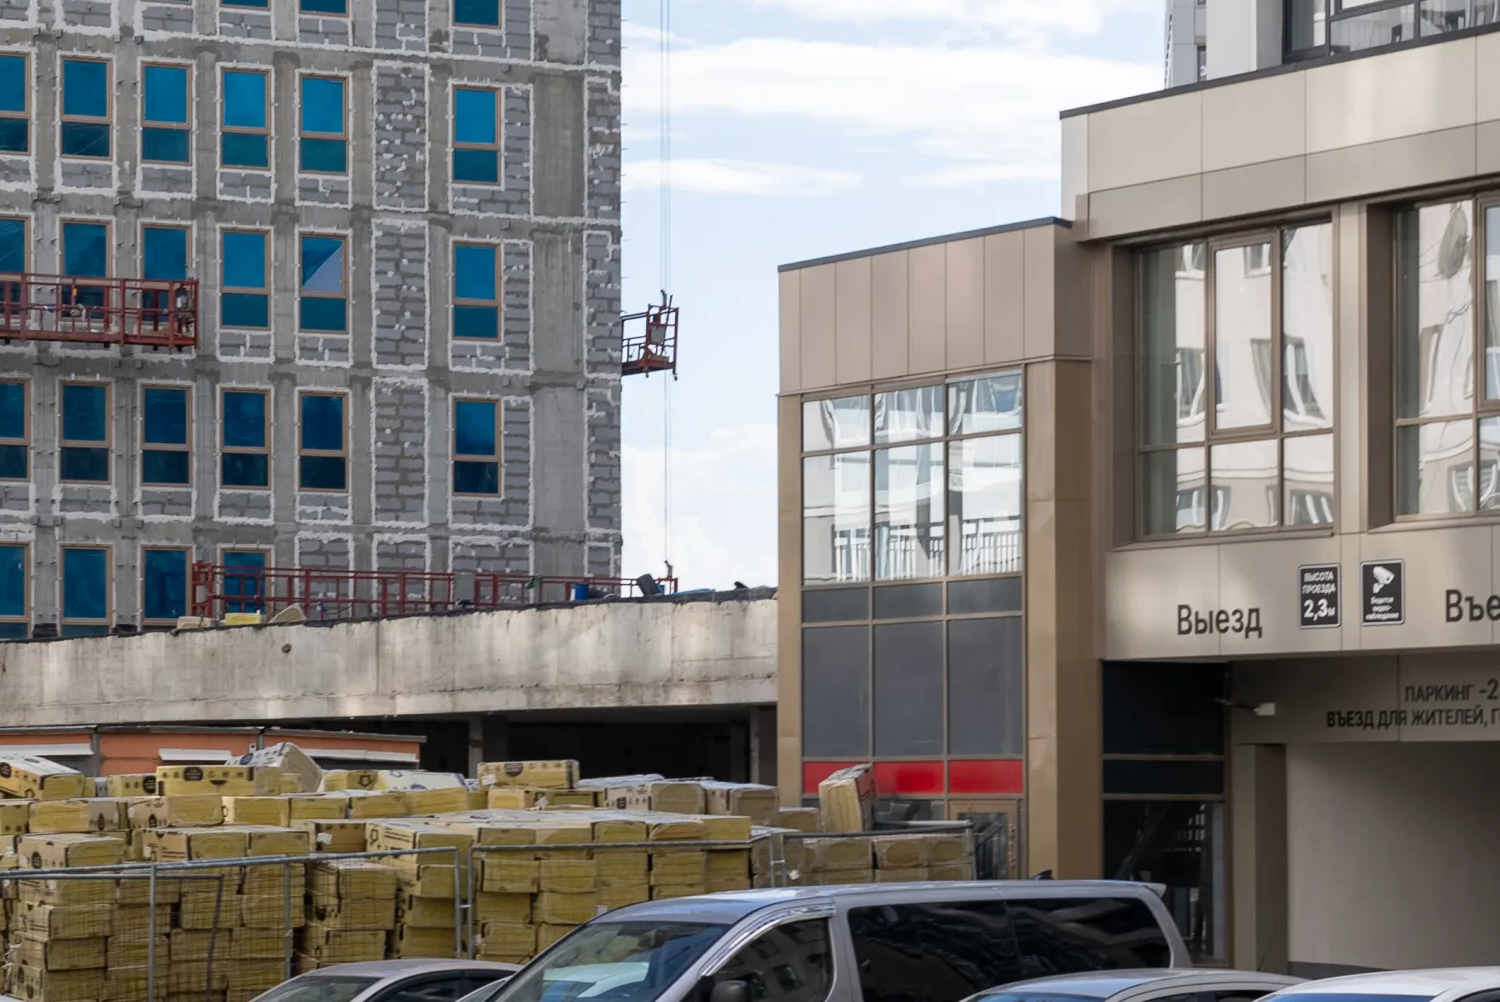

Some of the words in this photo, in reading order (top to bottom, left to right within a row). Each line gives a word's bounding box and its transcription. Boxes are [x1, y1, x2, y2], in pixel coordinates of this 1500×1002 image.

[1303, 571, 1334, 582] ВЫСОТА
[1302, 583, 1336, 594] ПРОЕЗДА
[1445, 589, 1500, 622] Въе
[1177, 604, 1263, 639] Выезд
[1404, 684, 1474, 702] ПАРКИНГ
[1326, 710, 1374, 730] ВЪЕЗД
[1377, 709, 1408, 729] ДЛЯ
[1411, 704, 1488, 728] ЖИТЕЛЕЙ,
